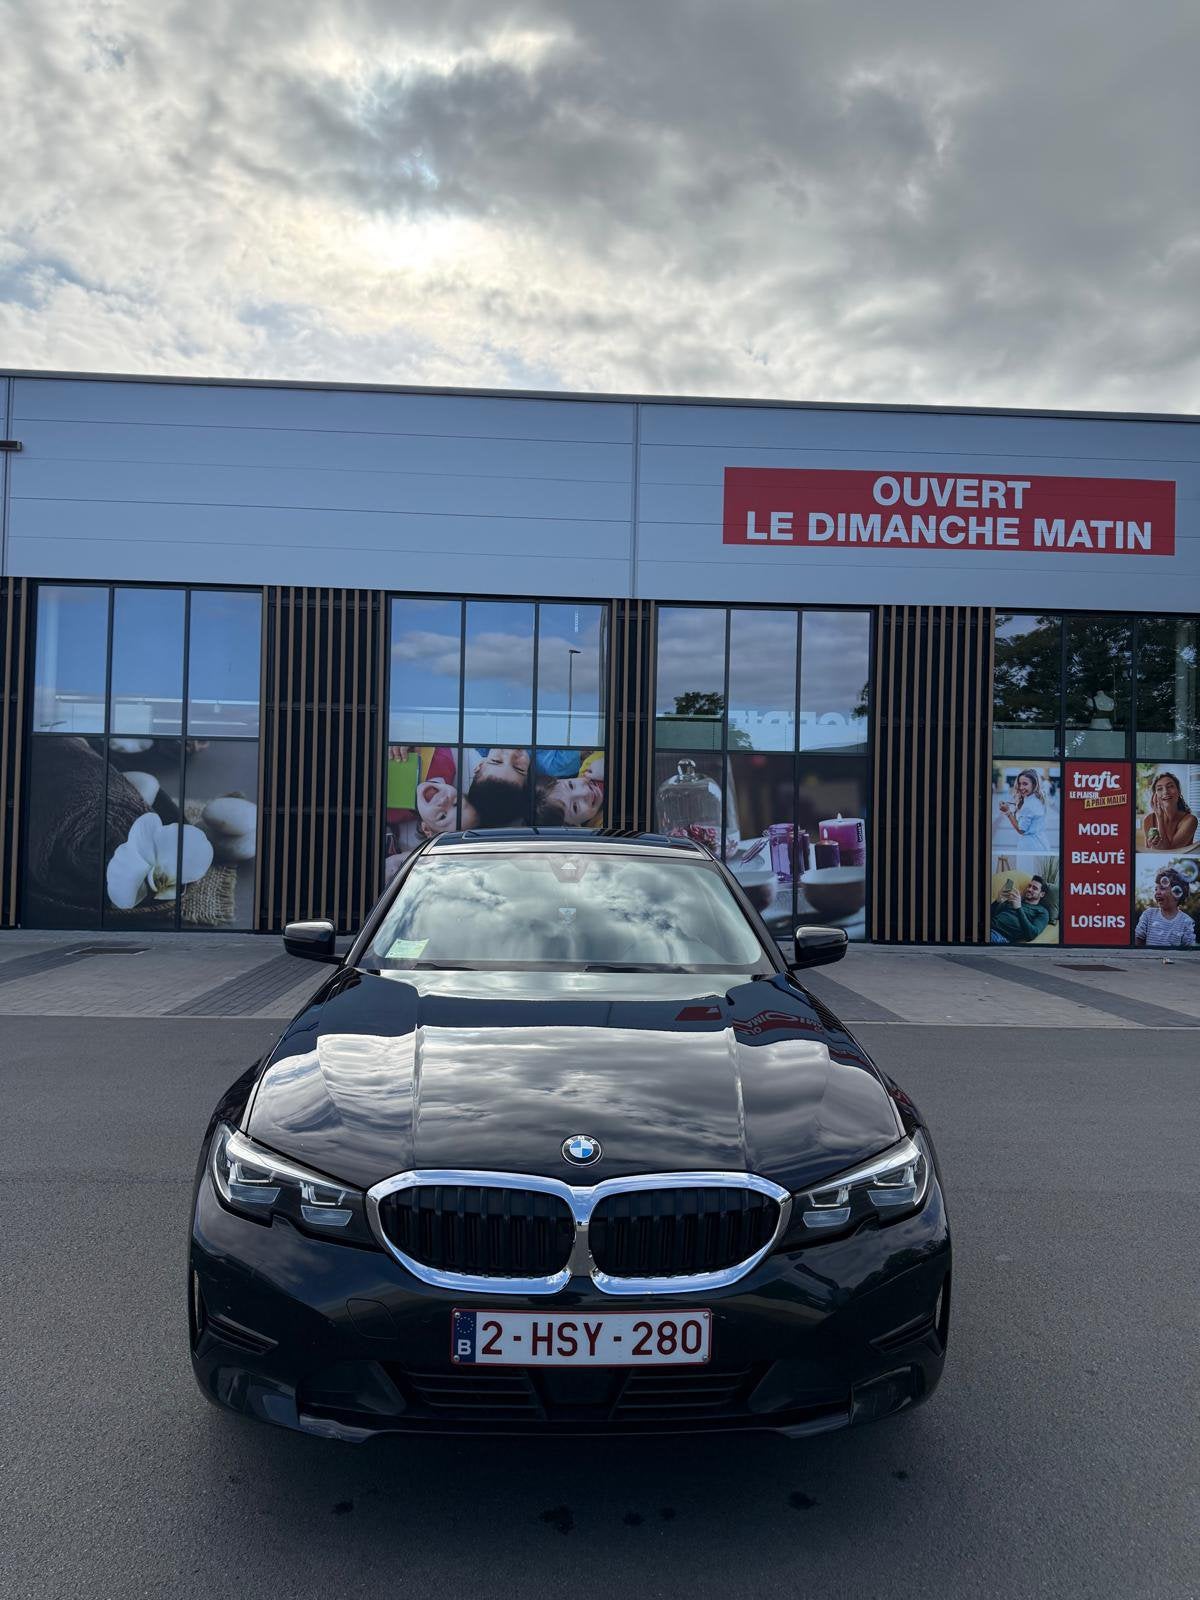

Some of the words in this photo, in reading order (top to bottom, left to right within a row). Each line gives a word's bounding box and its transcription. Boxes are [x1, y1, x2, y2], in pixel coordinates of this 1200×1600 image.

[872, 475, 1031, 509] OUVERT
[746, 510, 794, 541] LE
[807, 512, 1020, 546] DIMANCHE
[1033, 518, 1152, 550] MATIN
[1073, 770, 1121, 791] trafic
[1069, 791, 1077, 799] LE
[1076, 791, 1099, 800] PLAISIR
[1091, 798, 1106, 807] PRIX
[1106, 795, 1126, 806] MALIN
[1078, 823, 1119, 836] MODE
[1071, 849, 1126, 865] BEAUTÉ
[1070, 883, 1126, 896] MAISON
[1071, 915, 1126, 928] LOISIRS
[457, 1339, 472, 1355] B
[481, 1319, 702, 1357] 2-HSY-280
